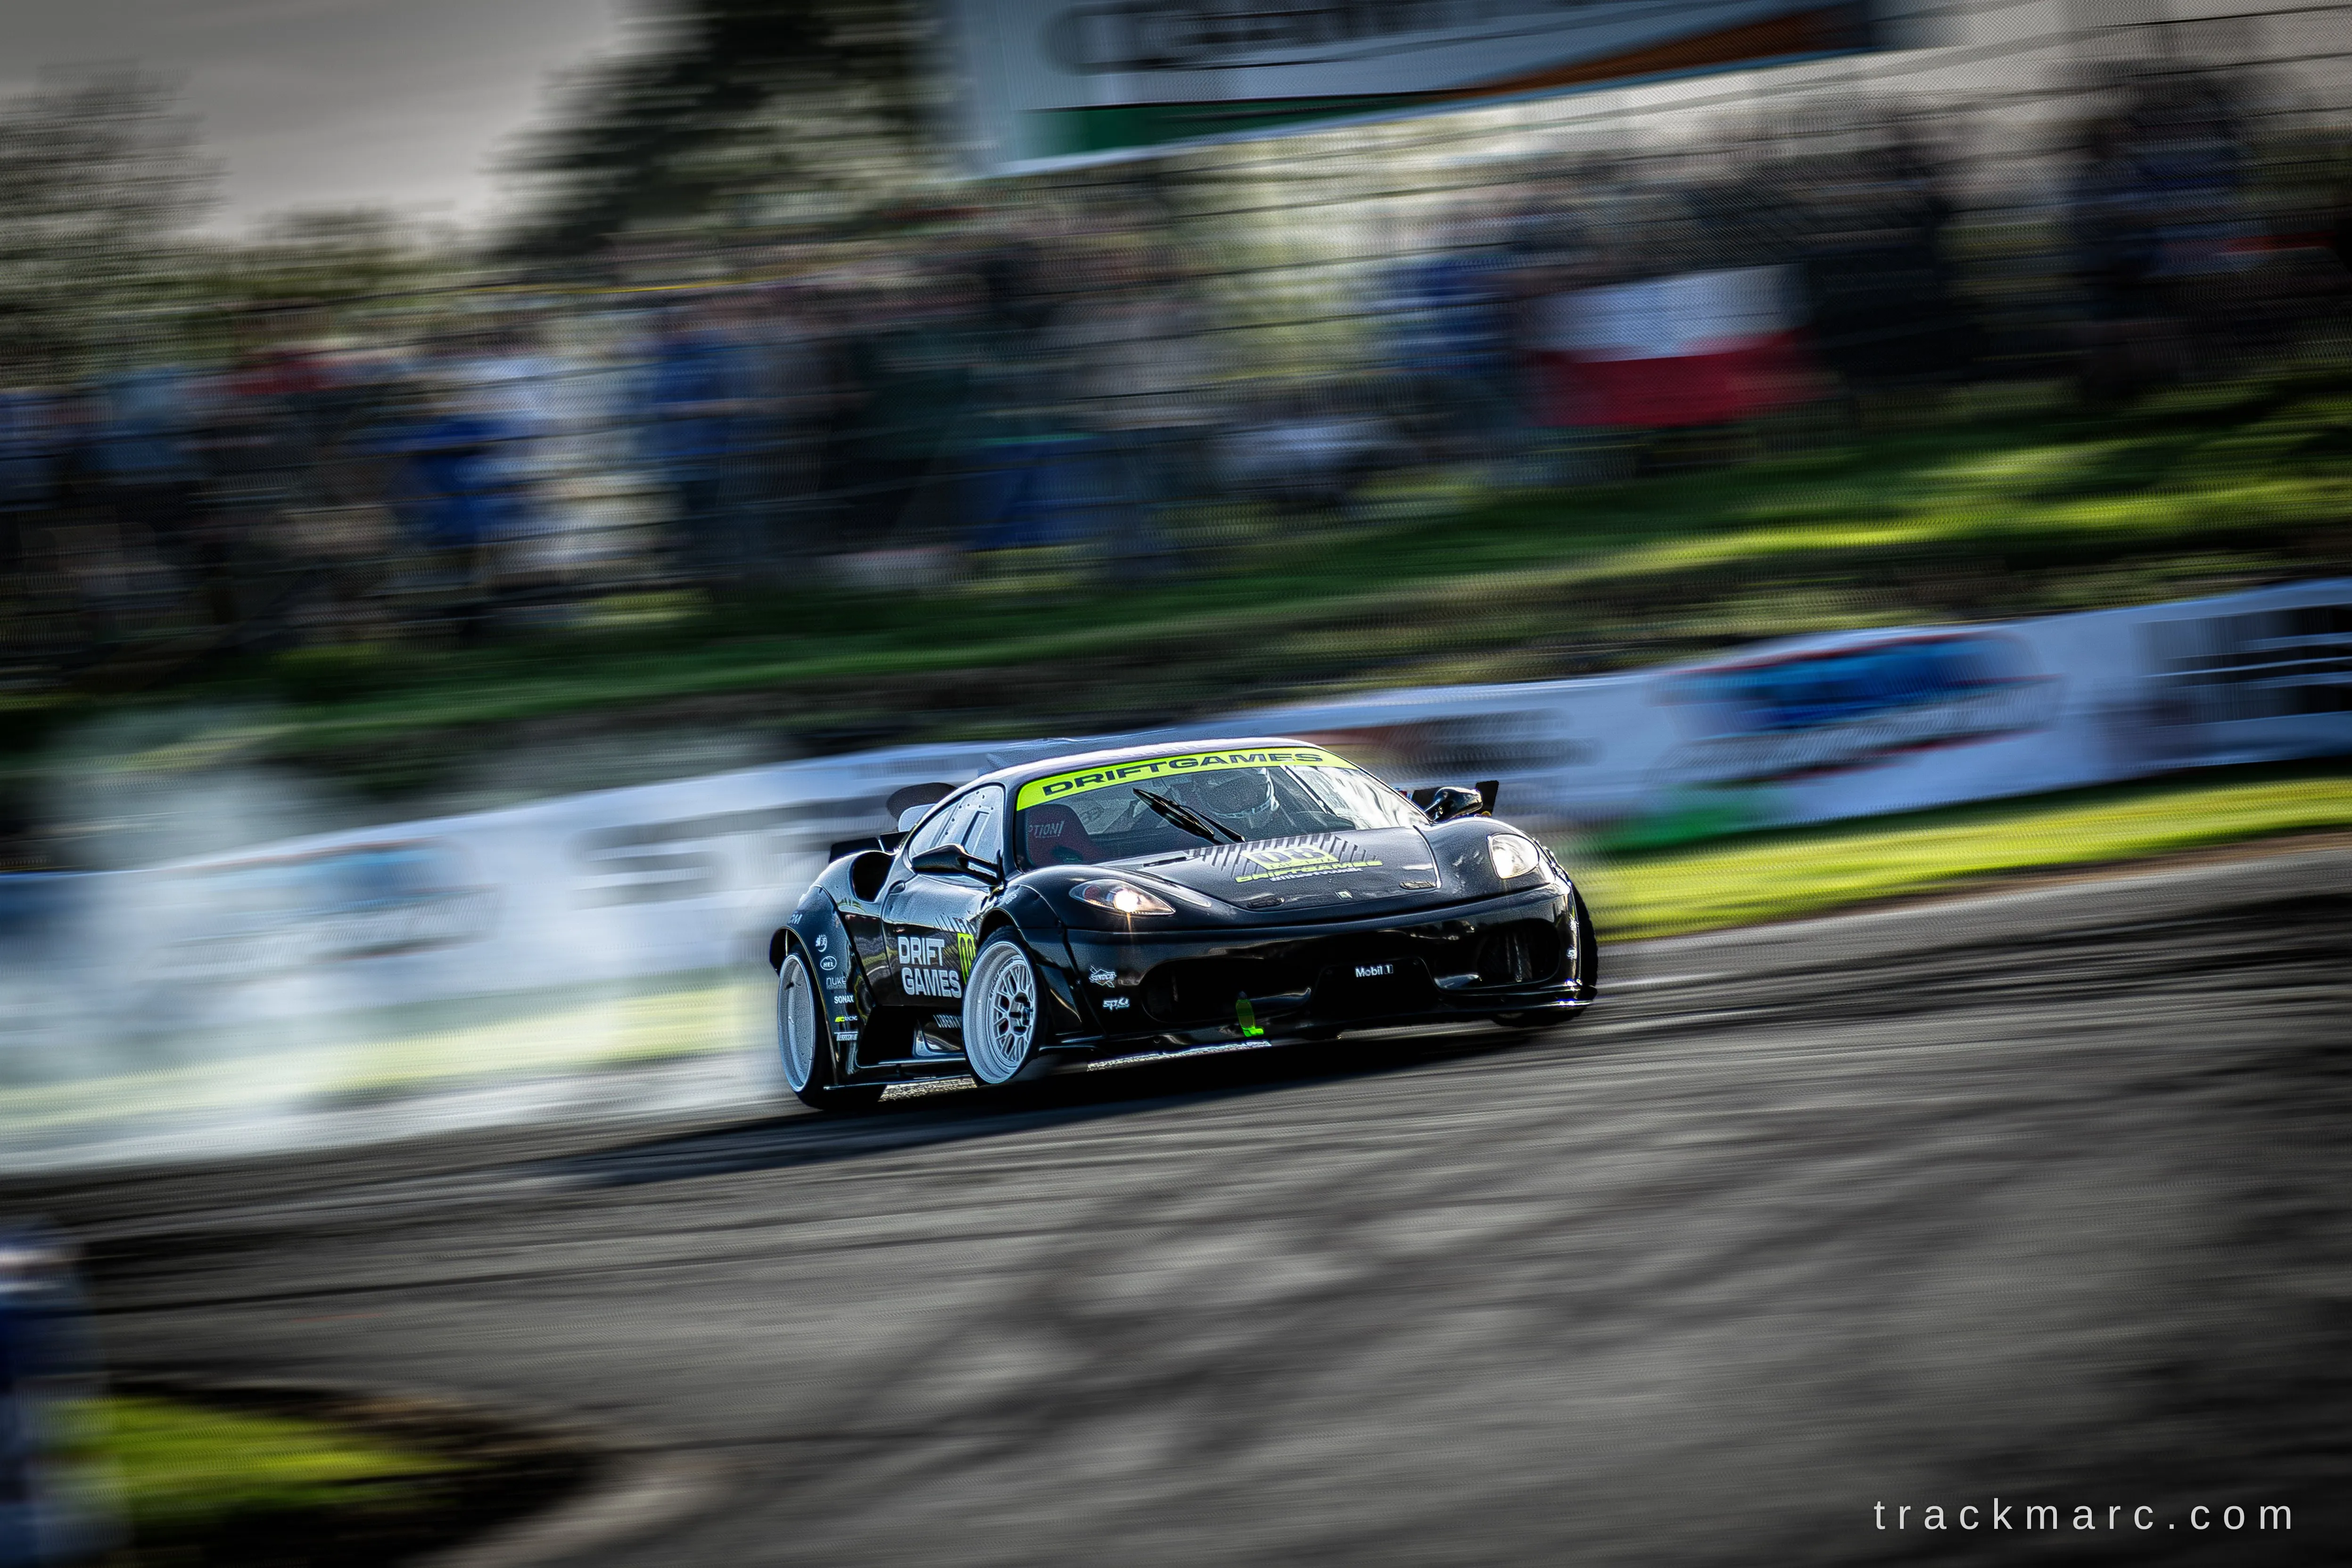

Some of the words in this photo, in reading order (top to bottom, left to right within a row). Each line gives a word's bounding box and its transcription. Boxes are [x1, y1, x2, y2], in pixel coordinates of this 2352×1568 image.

[1042, 753, 1324, 797] DRIFTGAMES
[1236, 861, 1383, 883] DRIFTGAMES
[898, 936, 944, 966] DRIFT
[826, 976, 847, 987] nuke
[902, 967, 961, 998] GAMES
[1355, 965, 1383, 978] Mobil
[834, 994, 854, 1004] SONAX
